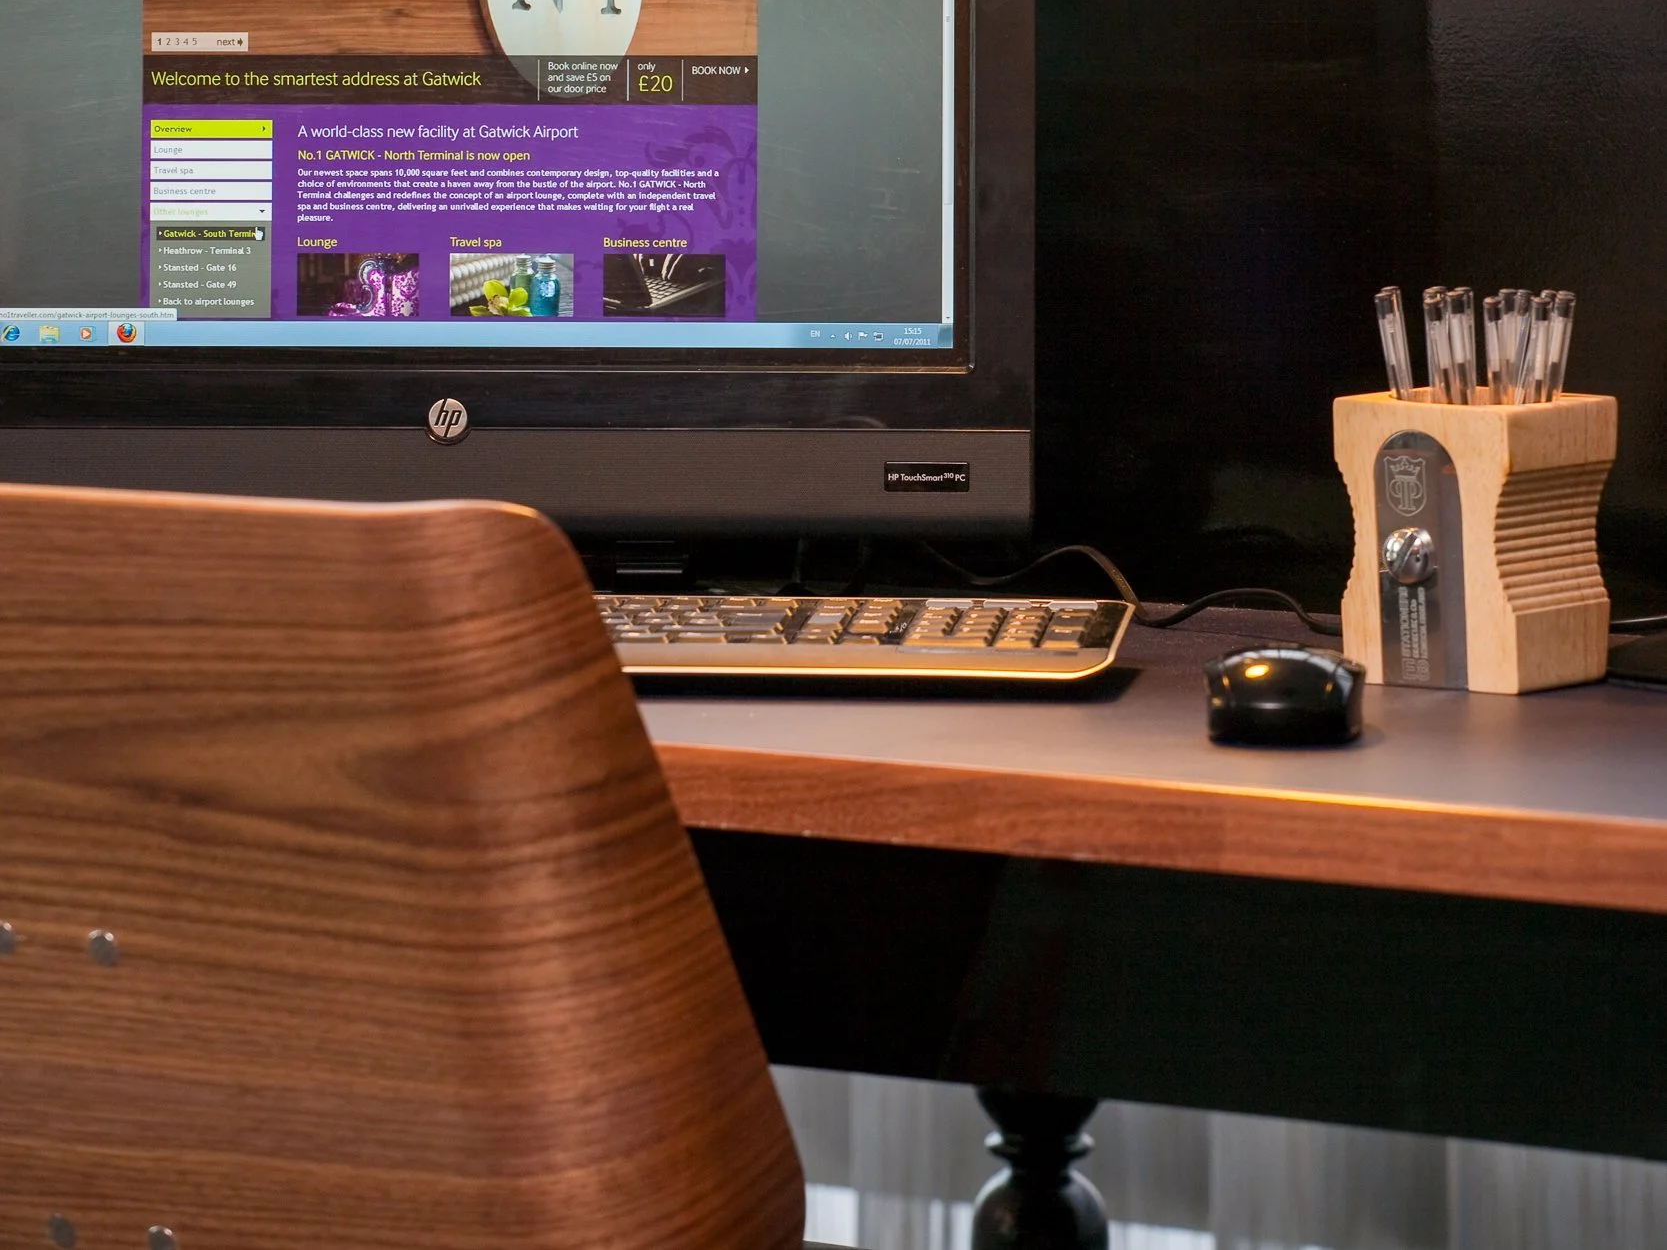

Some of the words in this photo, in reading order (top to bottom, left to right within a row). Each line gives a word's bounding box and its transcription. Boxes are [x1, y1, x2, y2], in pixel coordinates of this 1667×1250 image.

[548, 62, 570, 70] Book
[572, 62, 598, 70] online
[638, 62, 656, 72] only
[692, 66, 717, 75] BOOK
[719, 66, 741, 75] NOW
[152, 72, 221, 85] Welcome
[225, 73, 240, 85] to
[244, 72, 269, 86] the
[274, 73, 338, 86] smartest
[342, 72, 400, 86] address
[404, 73, 418, 86] at
[422, 72, 481, 86] Gatwick
[548, 73, 564, 81] and
[587, 73, 598, 81] £5
[639, 75, 672, 92] £20
[564, 84, 584, 93] door
[586, 84, 606, 94] price
[298, 125, 308, 137] A
[311, 125, 383, 138] world-class
[388, 128, 415, 138] new
[418, 125, 459, 141] facility
[463, 126, 476, 138] at
[479, 125, 530, 138] Gatwick
[533, 126, 578, 141] Airport
[154, 146, 182, 155] Lounge
[298, 150, 321, 161] No.1
[326, 149, 375, 161] GATWICK
[385, 150, 415, 161] North
[417, 149, 464, 161] Terminal
[466, 150, 474, 161] is
[478, 152, 500, 160] now
[502, 152, 530, 162] open
[154, 166, 177, 174] Travel
[298, 168, 312, 176] Our
[314, 169, 343, 177] newest
[346, 170, 369, 178] space
[370, 170, 392, 178] spans
[395, 169, 420, 177] 10,000
[470, 169, 484, 177] and
[486, 169, 524, 177] combines
[526, 170, 583, 178] contemporary
[583, 169, 612, 178] design,
[615, 169, 659, 178] top-quality
[714, 170, 719, 178] a
[298, 180, 325, 188] choice
[496, 180, 514, 188] from
[516, 180, 530, 188] the
[533, 180, 558, 188] bustle
[559, 180, 568, 188] of
[570, 180, 584, 188] the
[585, 180, 616, 189] airport.
[619, 180, 636, 188] No.1
[639, 180, 676, 188] GATWICK
[684, 181, 706, 189] North
[297, 190, 332, 198] Terminal
[334, 191, 374, 200] challenges
[393, 191, 431, 199] redefines
[449, 192, 482, 200] concept
[506, 192, 534, 200] airport
[535, 192, 565, 201] lounge,
[568, 192, 604, 201] complete
[639, 192, 691, 201] independent
[693, 192, 716, 200] travel
[298, 214, 333, 223] pleasure.
[298, 237, 337, 249] Lounge
[450, 236, 480, 247] Travel
[484, 240, 502, 249] spa
[604, 237, 650, 248] Business
[652, 238, 687, 247] centre
[246, 246, 251, 254] 3
[164, 264, 198, 272] Stansted
[228, 263, 236, 271] 16
[163, 281, 198, 289] Stansted
[206, 281, 225, 289] Gate
[195, 298, 222, 307] airport
[224, 298, 254, 307] lounges
[811, 330, 820, 338] EN
[894, 338, 930, 346] 07/07/2011
[434, 399, 462, 438] hp
